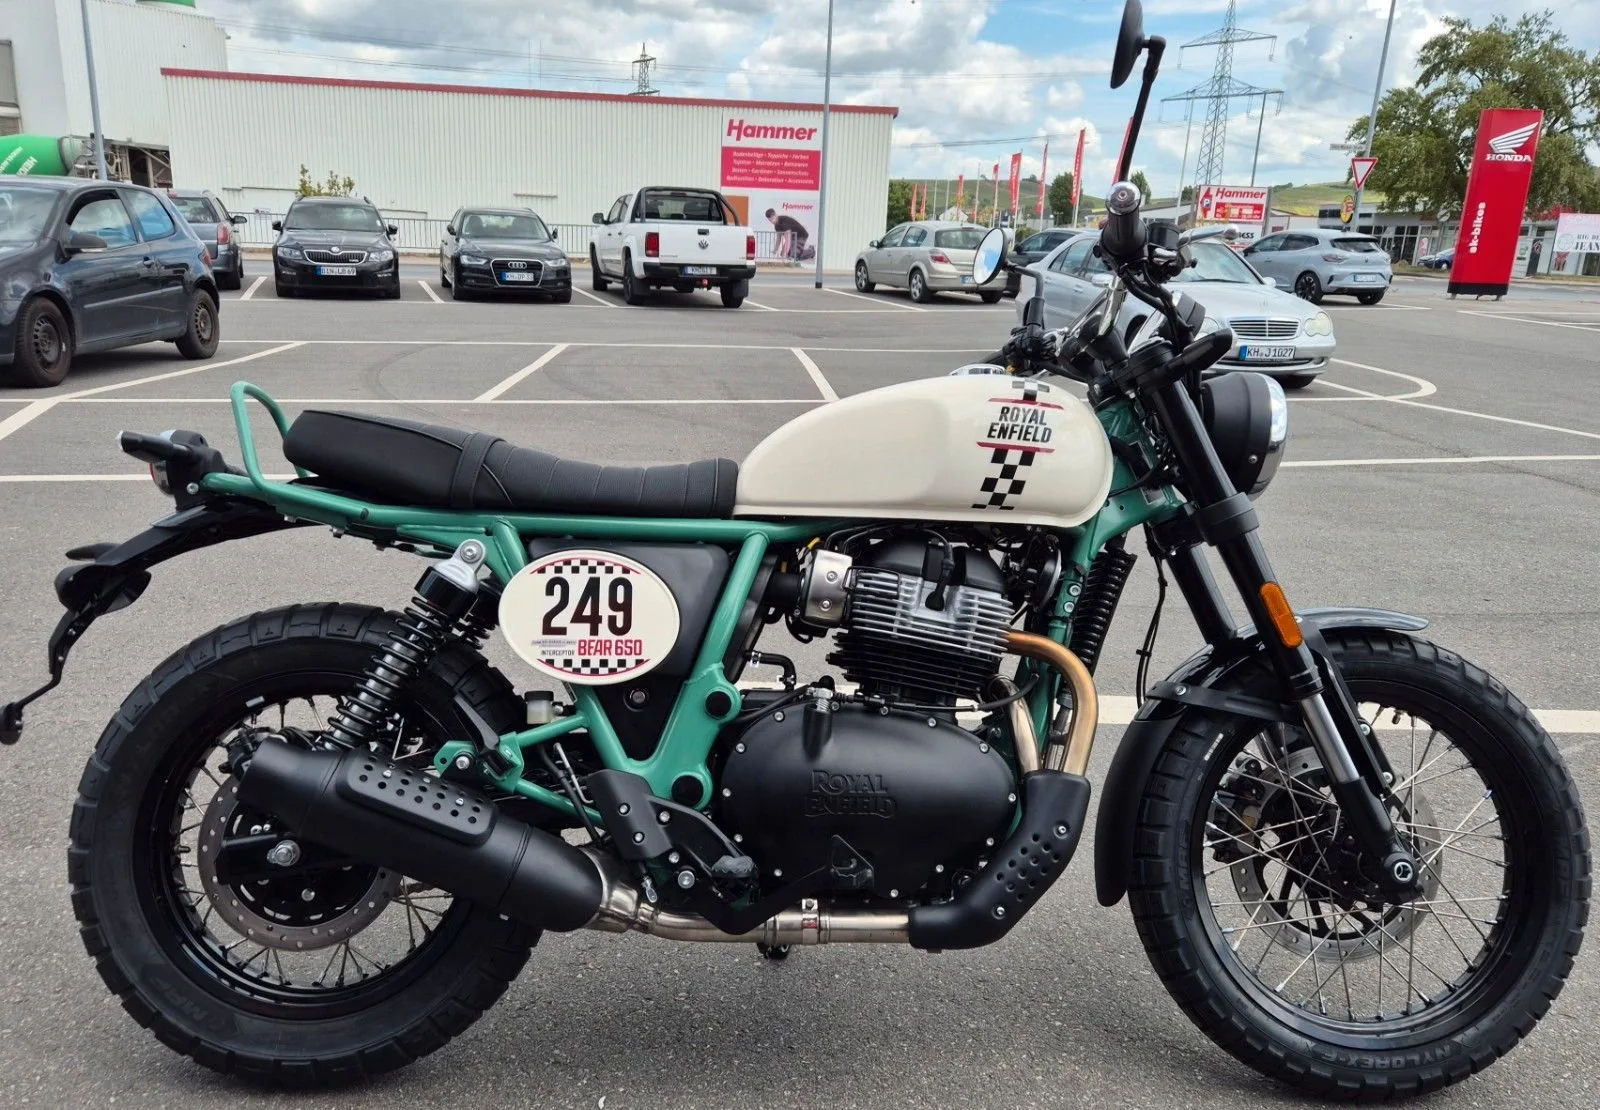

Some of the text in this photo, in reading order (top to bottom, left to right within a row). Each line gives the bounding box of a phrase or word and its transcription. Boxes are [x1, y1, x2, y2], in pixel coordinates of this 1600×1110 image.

[726, 119, 818, 141] Hammer
[1485, 153, 1533, 162] HONDA
[1215, 187, 1267, 199] Hammer
[782, 202, 814, 211] Hammer
[999, 406, 1047, 426] ROYAL
[987, 422, 1053, 443] ENFIELD
[542, 576, 633, 636] 249
[577, 639, 612, 656] BEAR
[614, 639, 643, 656] 650
[811, 769, 889, 795] ROYAL
[804, 795, 897, 819] ENFIELD
